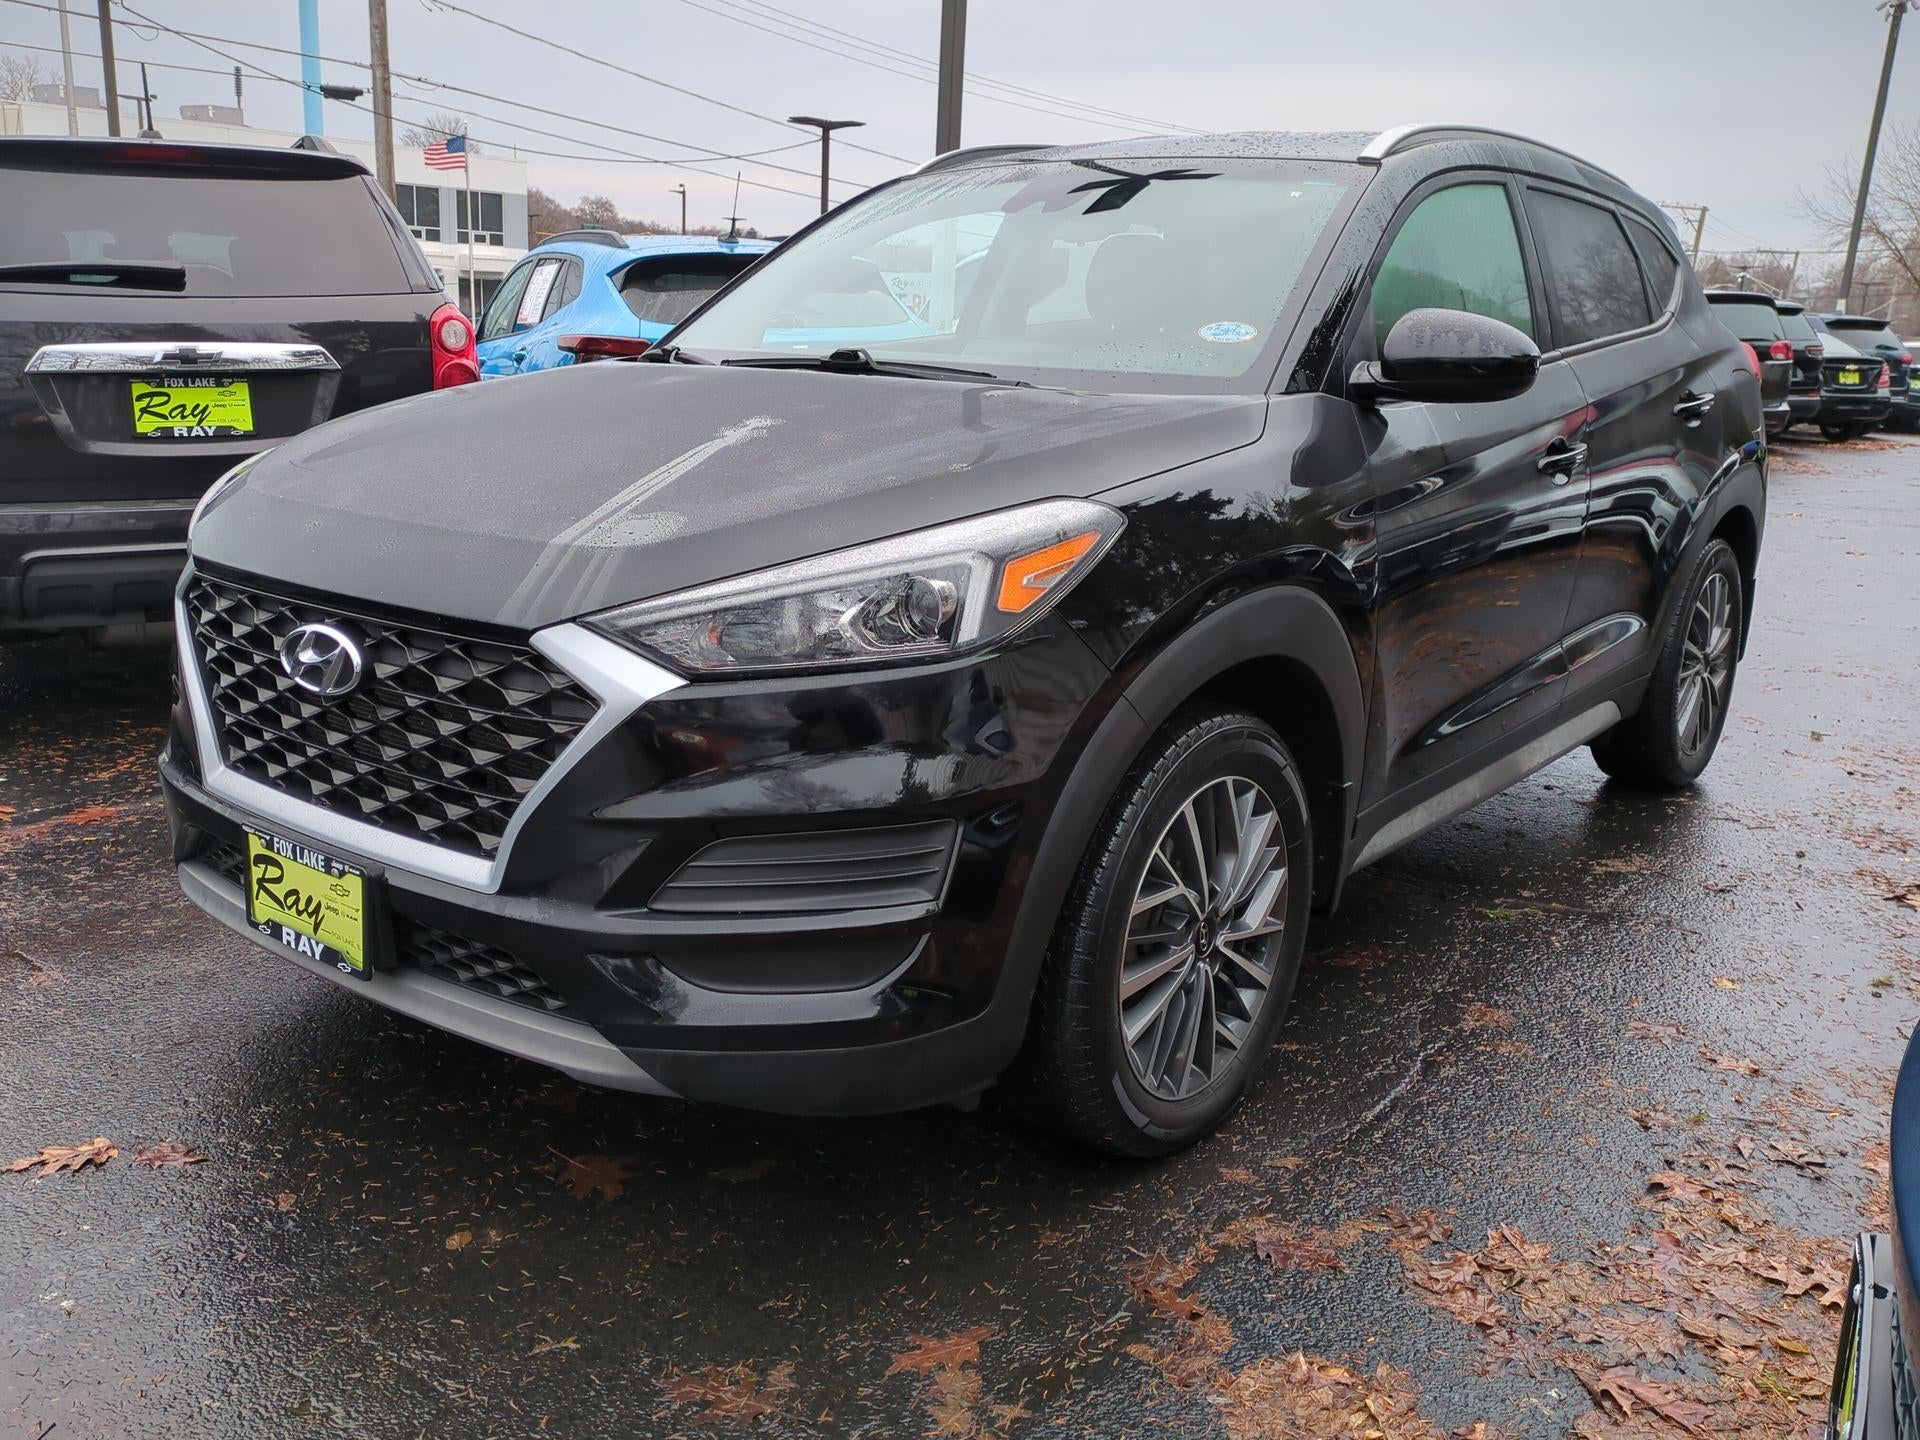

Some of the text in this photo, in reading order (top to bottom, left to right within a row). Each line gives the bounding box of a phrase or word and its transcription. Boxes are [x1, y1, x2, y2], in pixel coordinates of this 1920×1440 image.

[164, 378, 184, 387] FOX
[188, 377, 217, 387] LAKE
[135, 391, 212, 426] Ray
[173, 426, 216, 437] RAY
[273, 838, 326, 872] FOX LAKE
[253, 853, 325, 936] Ray
[324, 902, 339, 917] Jeep
[282, 925, 325, 961] RAY
